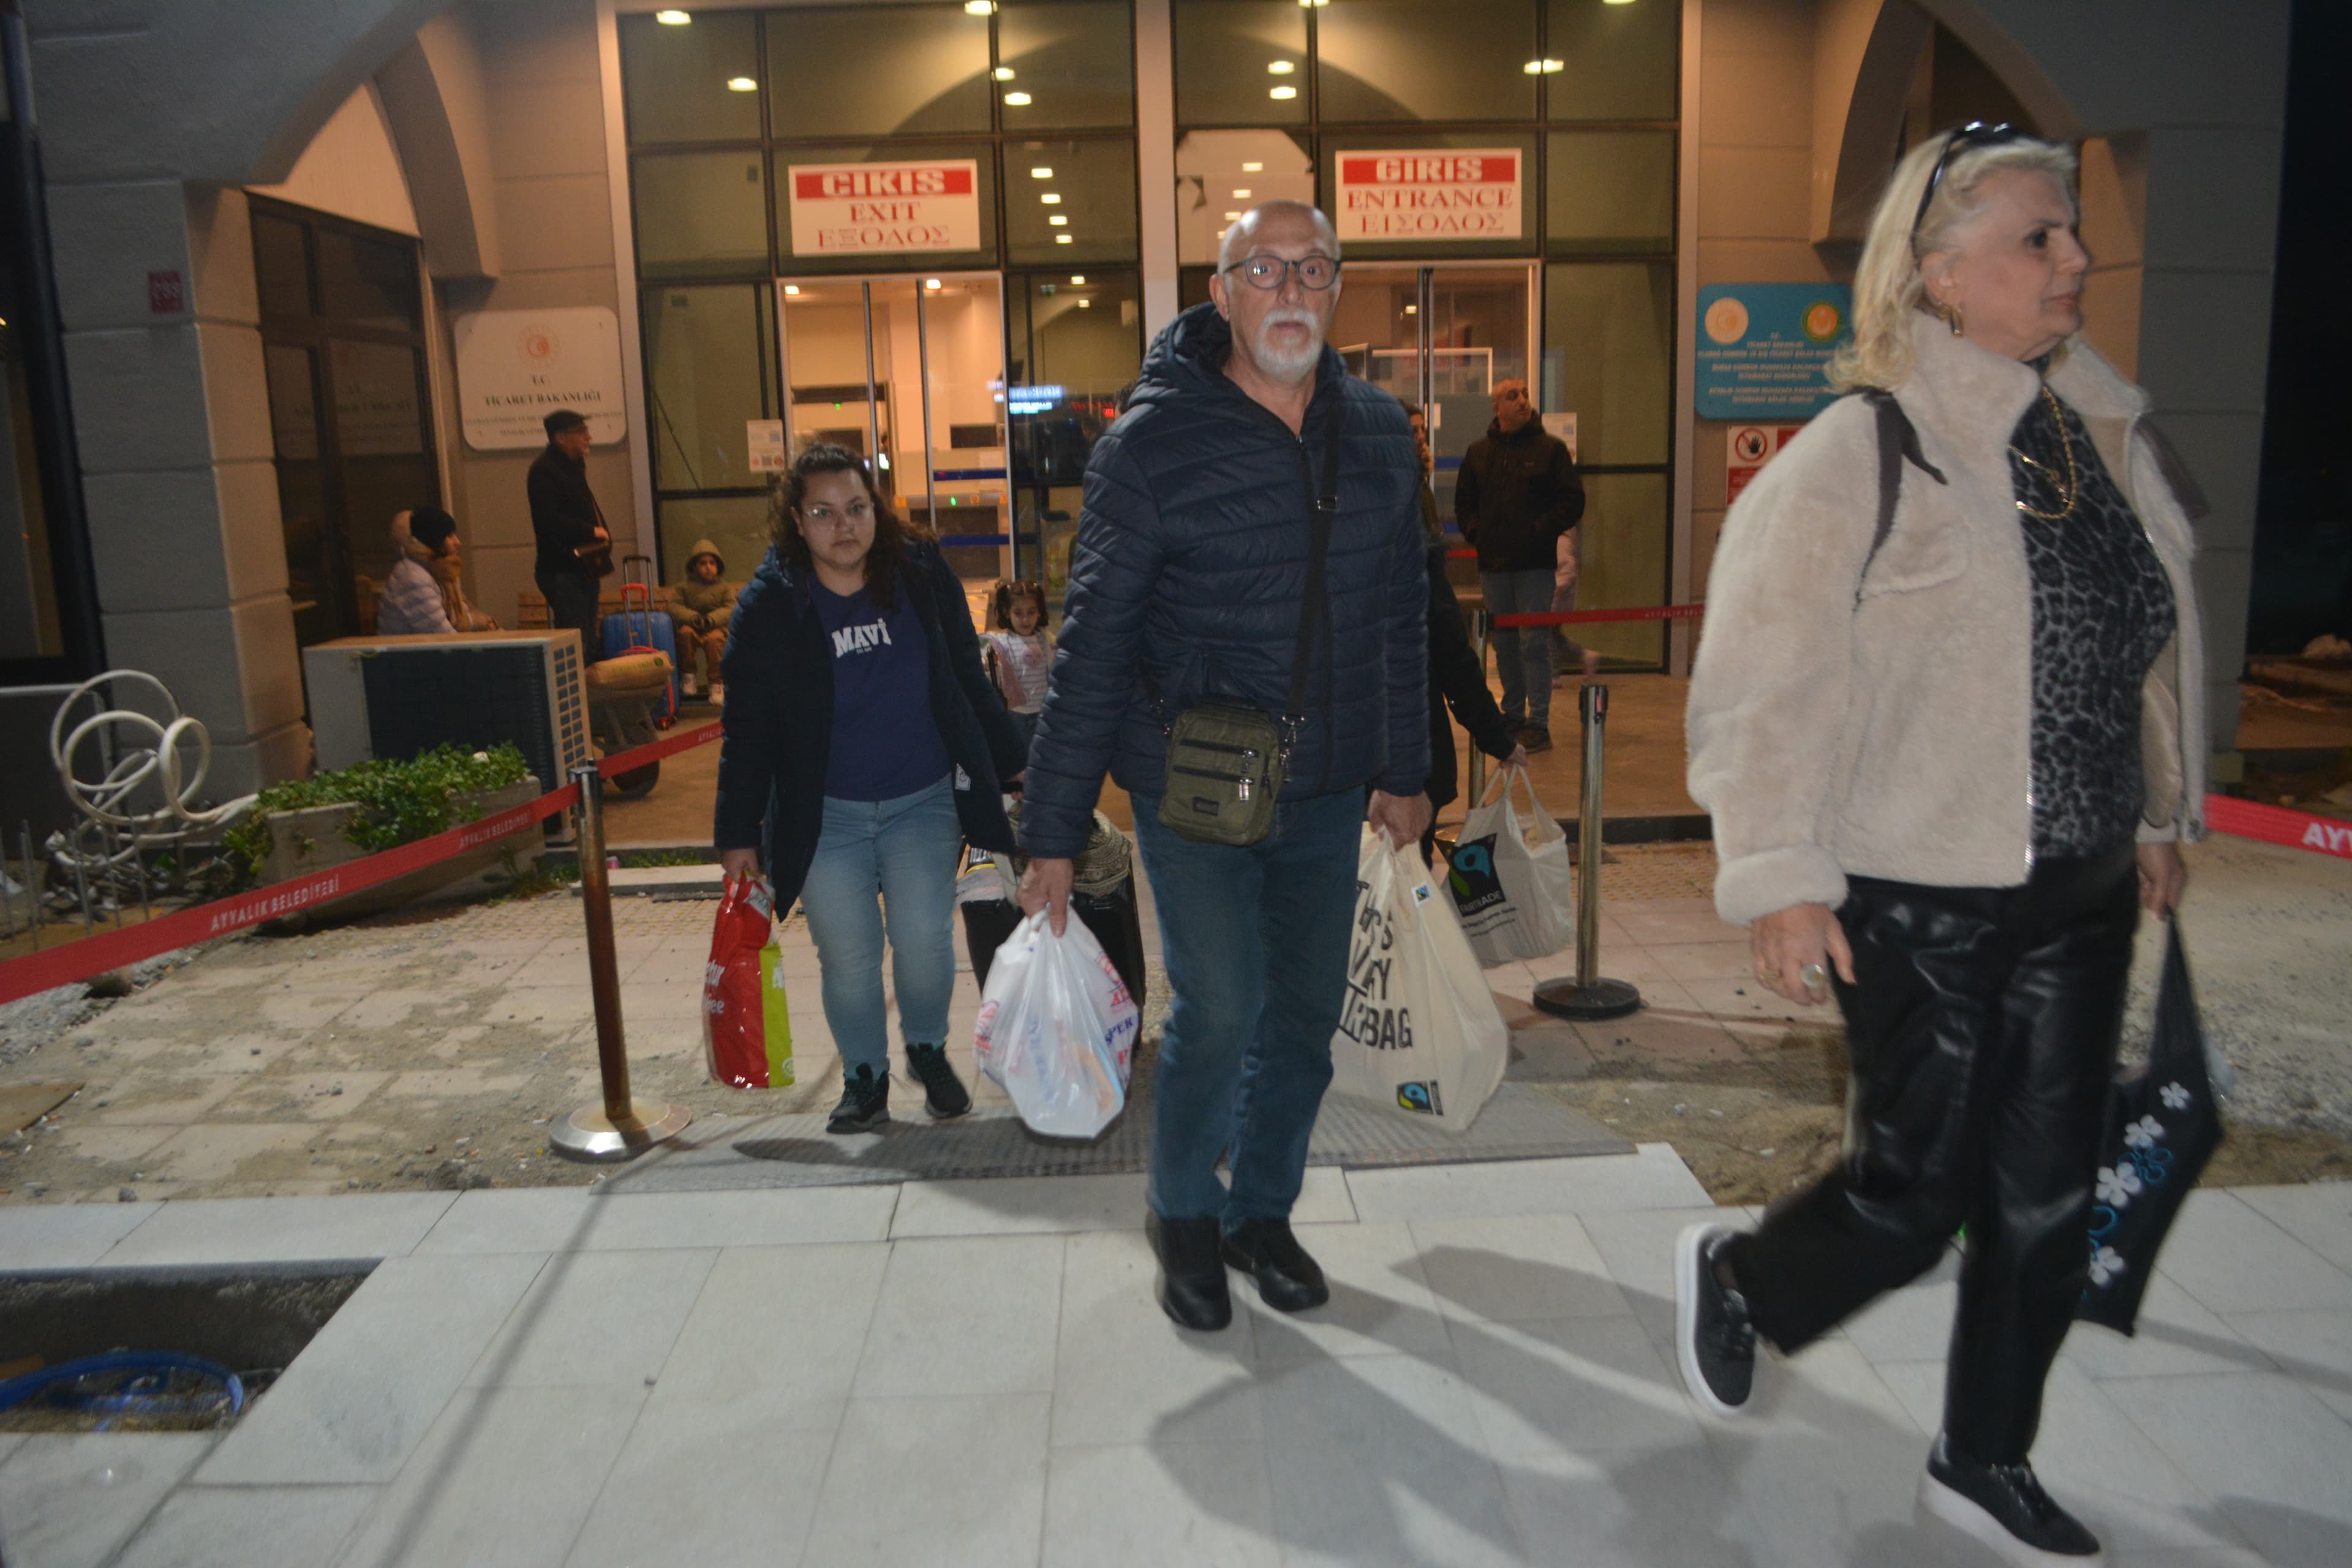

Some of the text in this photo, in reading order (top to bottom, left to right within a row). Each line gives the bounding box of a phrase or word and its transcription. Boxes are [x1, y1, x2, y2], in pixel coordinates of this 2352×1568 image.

[1347, 187, 1513, 209] ENTRANCE
[850, 201, 921, 224] EXIT
[831, 617, 892, 658] MAVİ
[210, 899, 268, 932] AYVALIK
